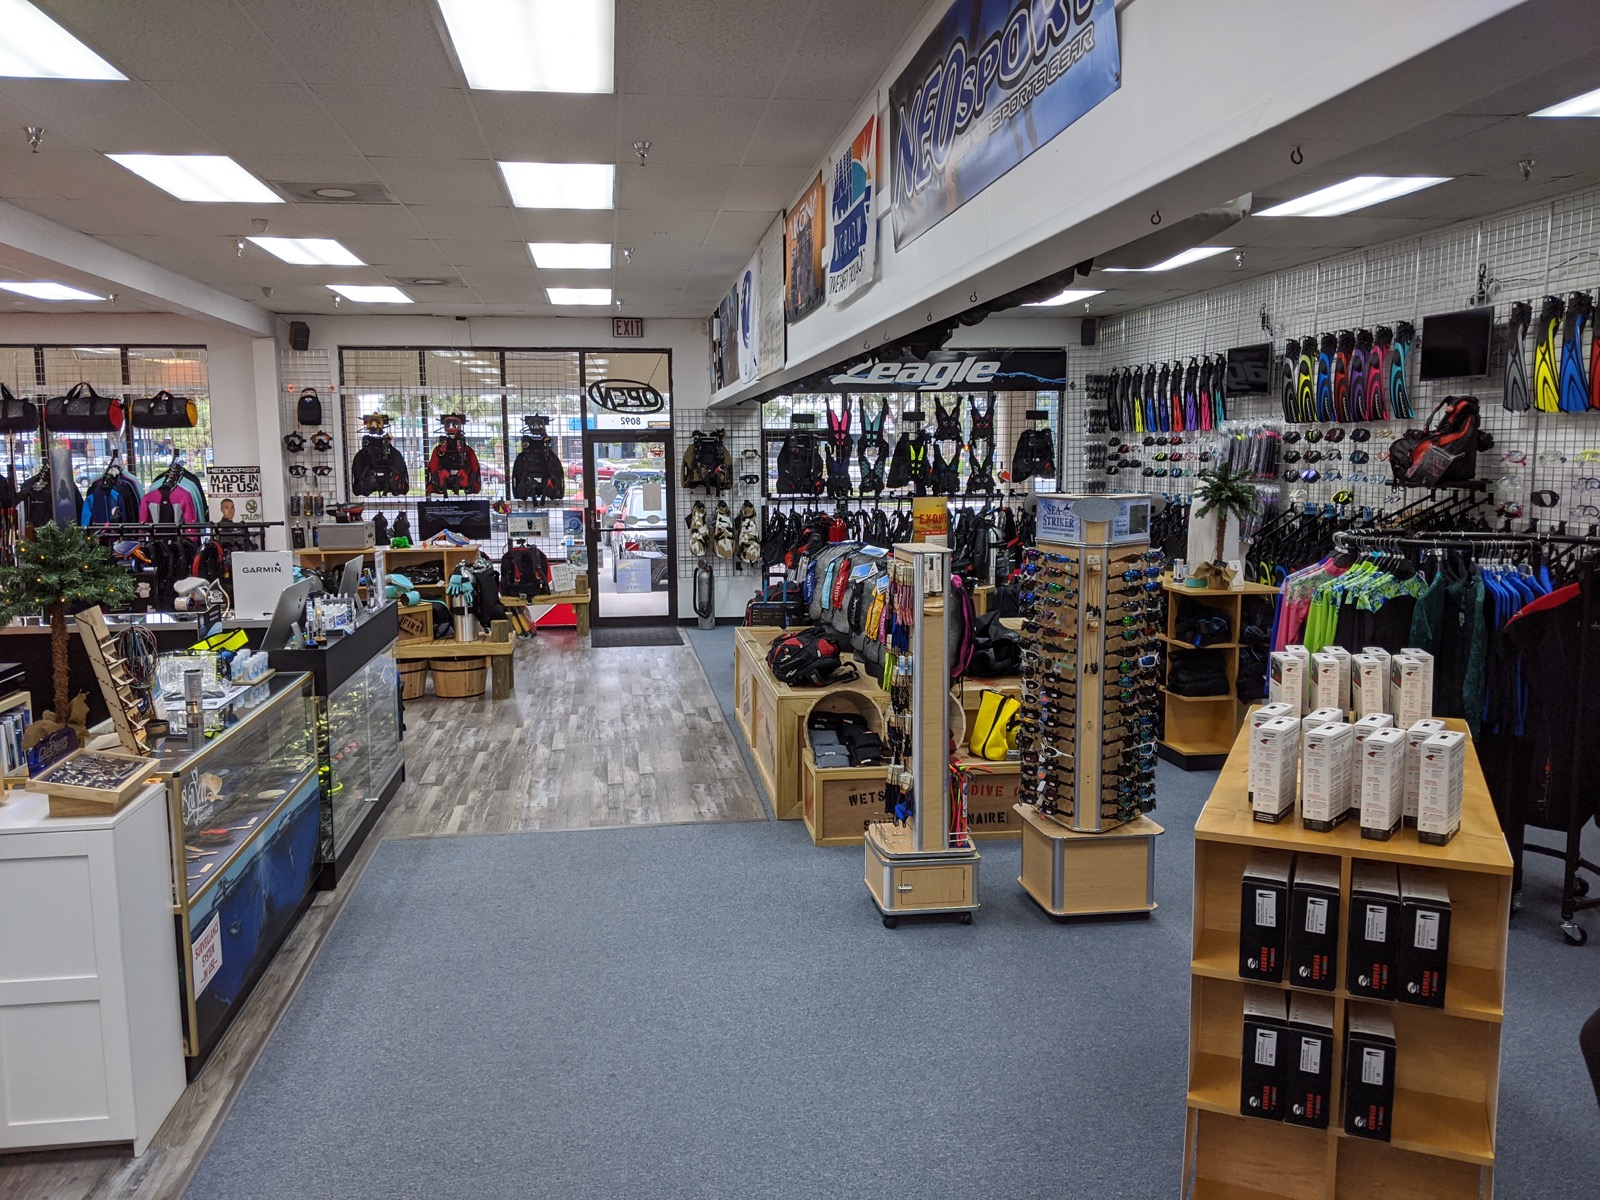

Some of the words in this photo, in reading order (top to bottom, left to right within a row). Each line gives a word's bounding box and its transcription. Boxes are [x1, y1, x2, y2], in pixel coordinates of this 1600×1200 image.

[1048, 24, 1095, 85] GEAR
[893, 0, 1096, 205] NEOSPOR
[616, 320, 640, 335] EXIT
[210, 474, 246, 484] MADE
[249, 474, 258, 483] IN
[210, 484, 234, 493] THE
[237, 482, 260, 492] USA
[1046, 504, 1061, 516] SEA
[1042, 514, 1074, 528] STRIKER
[971, 784, 1004, 797] DIVE
[848, 792, 886, 806] WETS
